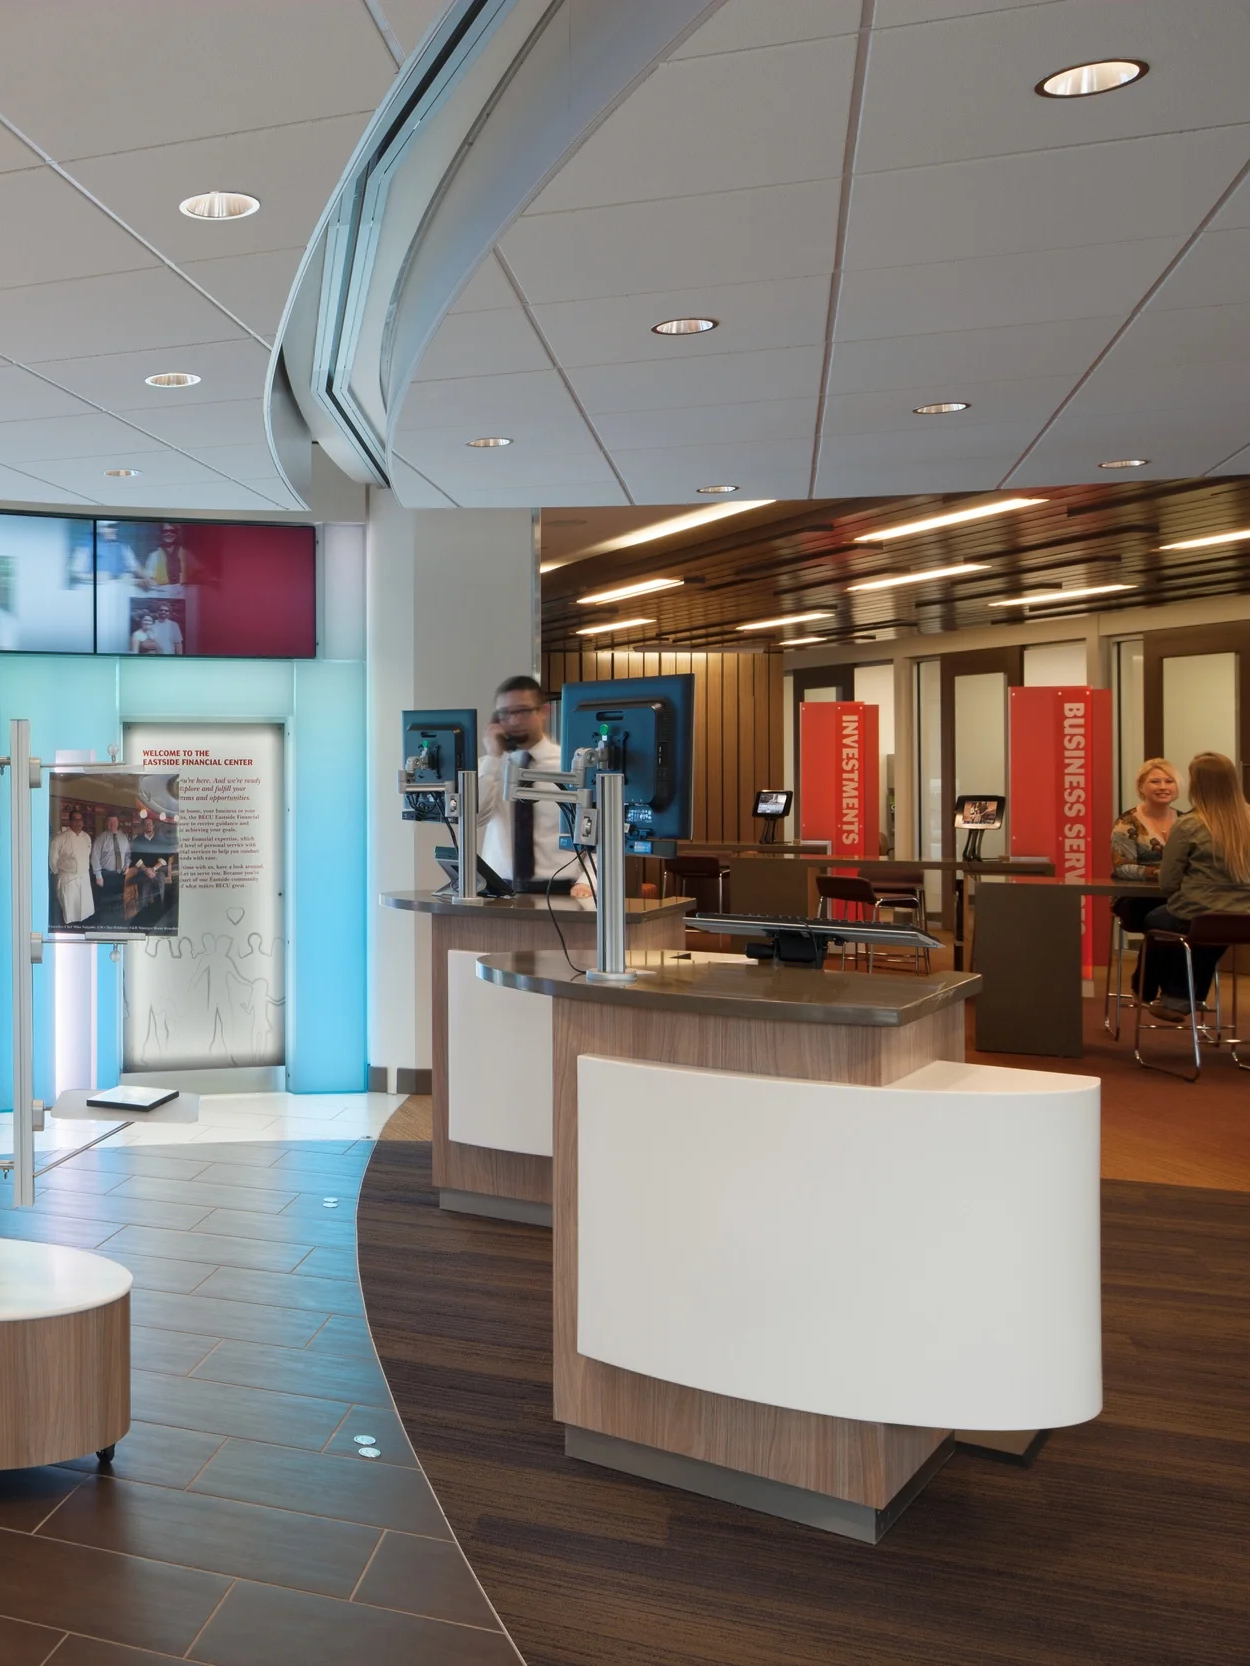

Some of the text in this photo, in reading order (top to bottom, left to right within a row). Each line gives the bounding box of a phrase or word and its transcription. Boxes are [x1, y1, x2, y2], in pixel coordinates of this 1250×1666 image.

[244, 777, 261, 785] ready
[842, 714, 859, 845] INVESTMENTS
[1064, 702, 1086, 818] BUSINESS
